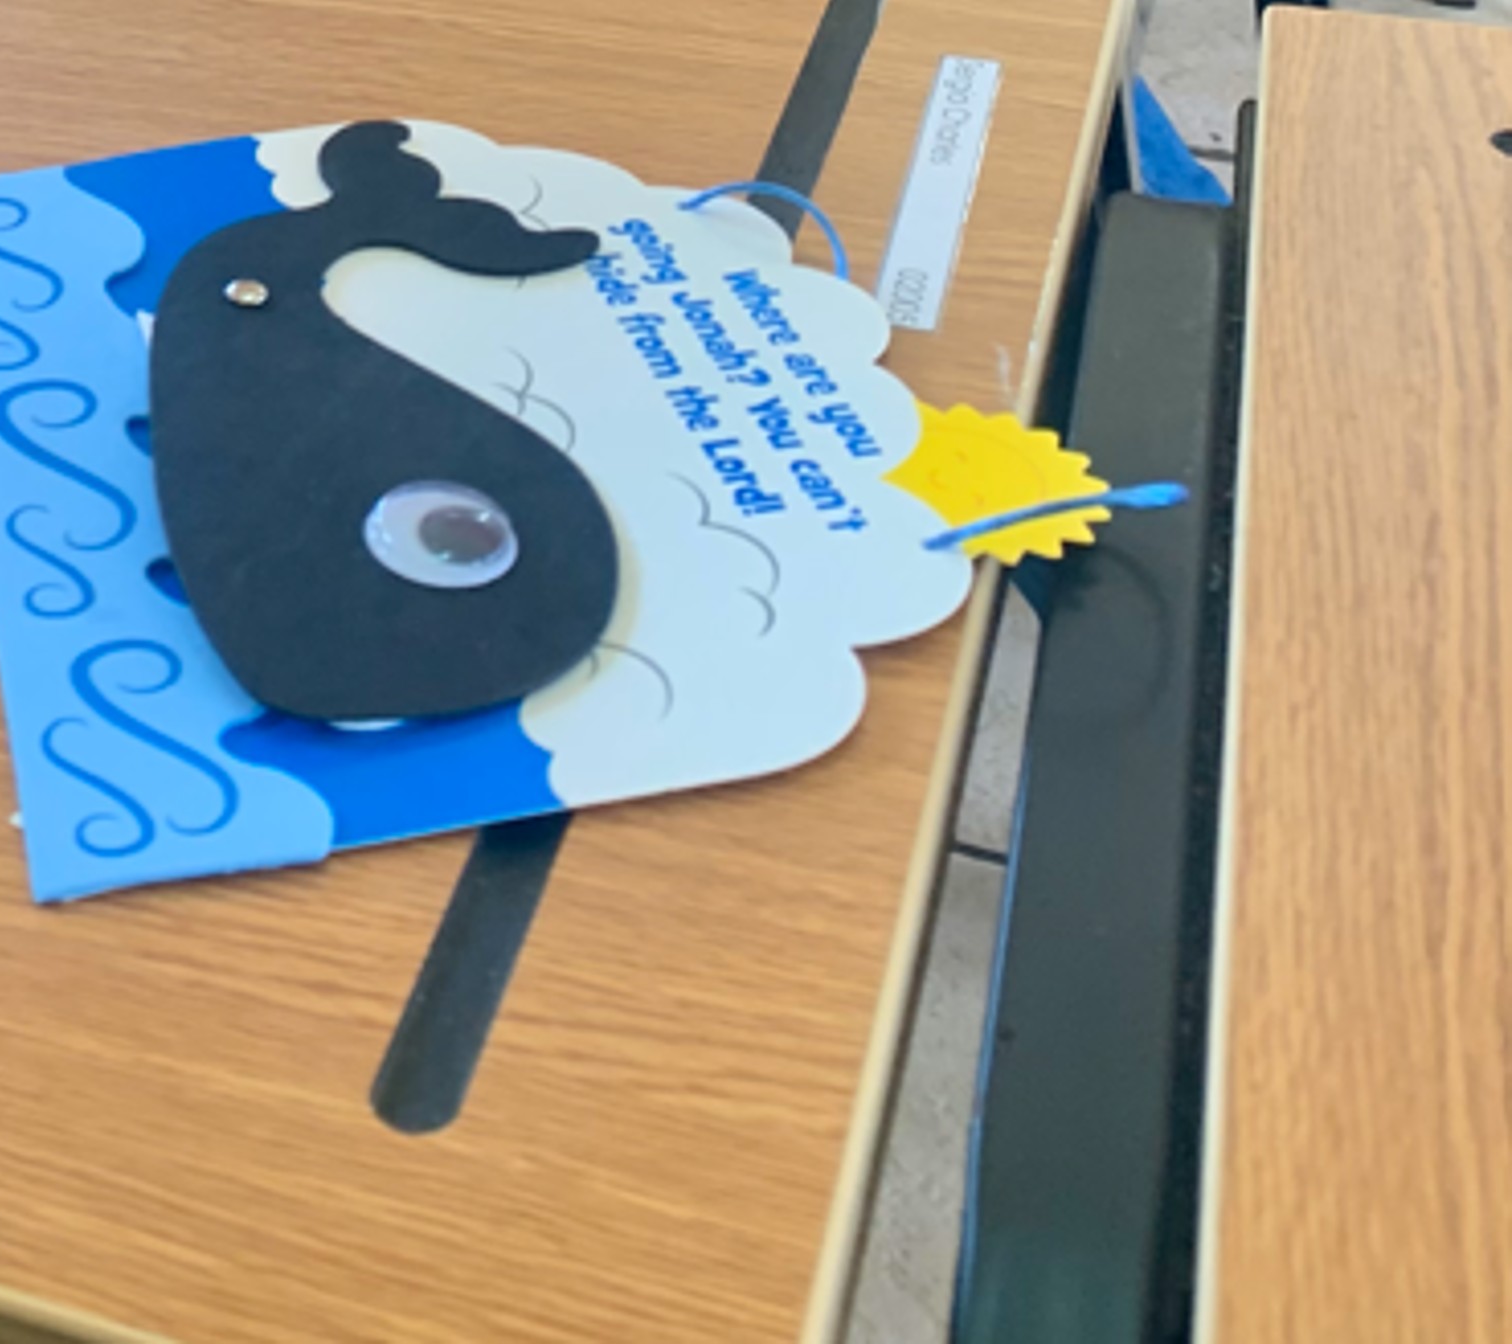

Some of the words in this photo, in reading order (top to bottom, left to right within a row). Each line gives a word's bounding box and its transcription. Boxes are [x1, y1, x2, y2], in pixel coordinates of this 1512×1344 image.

[722, 268, 799, 346] Where
[583, 252, 638, 307] hide
[616, 312, 684, 379] from
[665, 385, 720, 432] the
[700, 437, 787, 517] Lord!
[607, 218, 690, 284] going
[671, 291, 772, 389] Jonah?
[747, 396, 805, 451] You
[789, 457, 867, 532] can't
[783, 353, 837, 398] are
[807, 401, 882, 458] you
